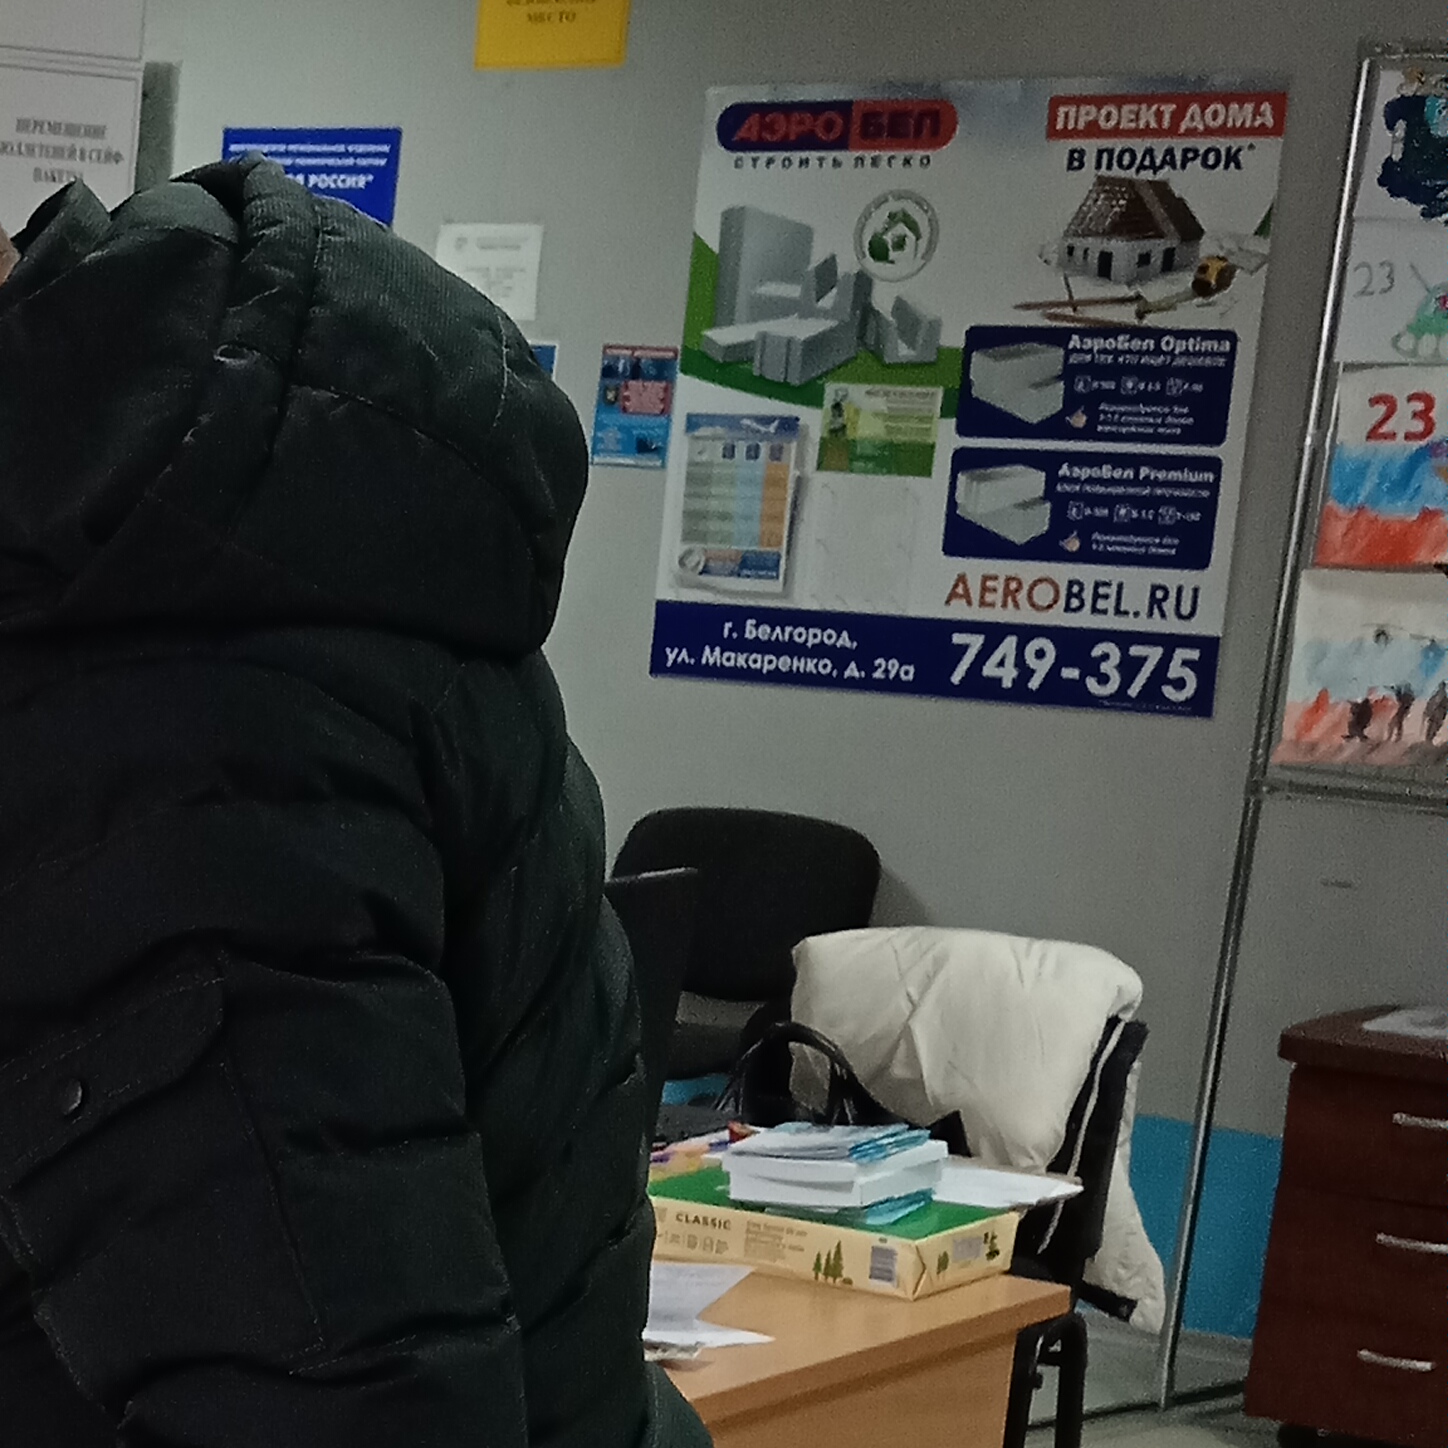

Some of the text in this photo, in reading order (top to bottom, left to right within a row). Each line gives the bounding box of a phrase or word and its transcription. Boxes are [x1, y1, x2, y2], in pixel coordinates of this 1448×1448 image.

[1056, 102, 1274, 134] ПРОЕКТ ДОМА
[734, 154, 932, 169] СТРОИТЬ ЛЕГКО
[1066, 147, 1087, 173] В
[1353, 259, 1395, 299] 23
[1160, 334, 1231, 355] Optima
[1365, 390, 1436, 443] 23
[1139, 465, 1215, 484] Premium
[944, 572, 1200, 621] AEROBEL.RU
[723, 618, 858, 650] г. Белгород,
[665, 645, 916, 682] ул. Макаренко, д. 29а
[950, 632, 1201, 703] 749-375
[675, 1212, 732, 1231] CLASSIC
